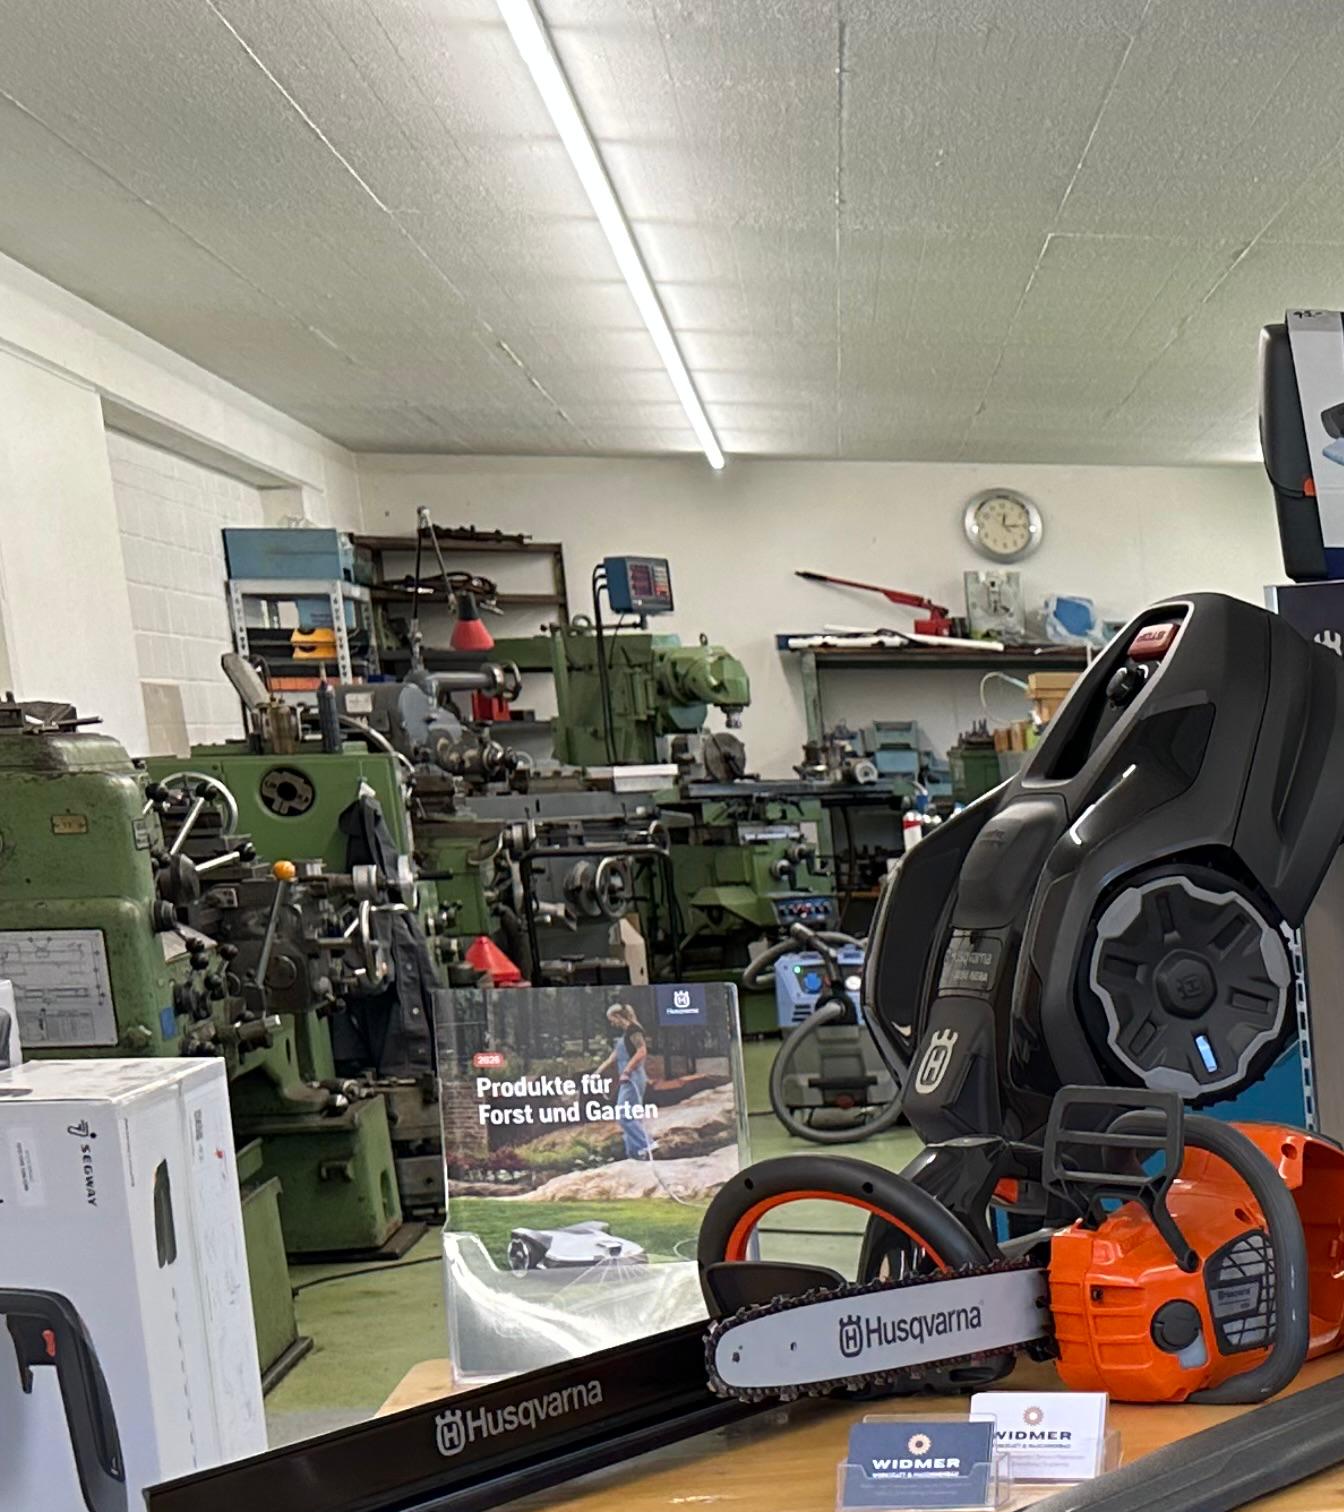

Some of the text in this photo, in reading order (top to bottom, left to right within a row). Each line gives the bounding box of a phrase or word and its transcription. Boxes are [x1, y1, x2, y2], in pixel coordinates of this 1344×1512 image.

[476, 1073, 613, 1099] Produkte für
[478, 1100, 660, 1125] Forst und Garten
[80, 1143, 98, 1208] SEGWAY
[866, 1304, 983, 1350] Husqvarna
[463, 1378, 604, 1443] Husqvarna
[871, 1457, 961, 1471] WIDMER
